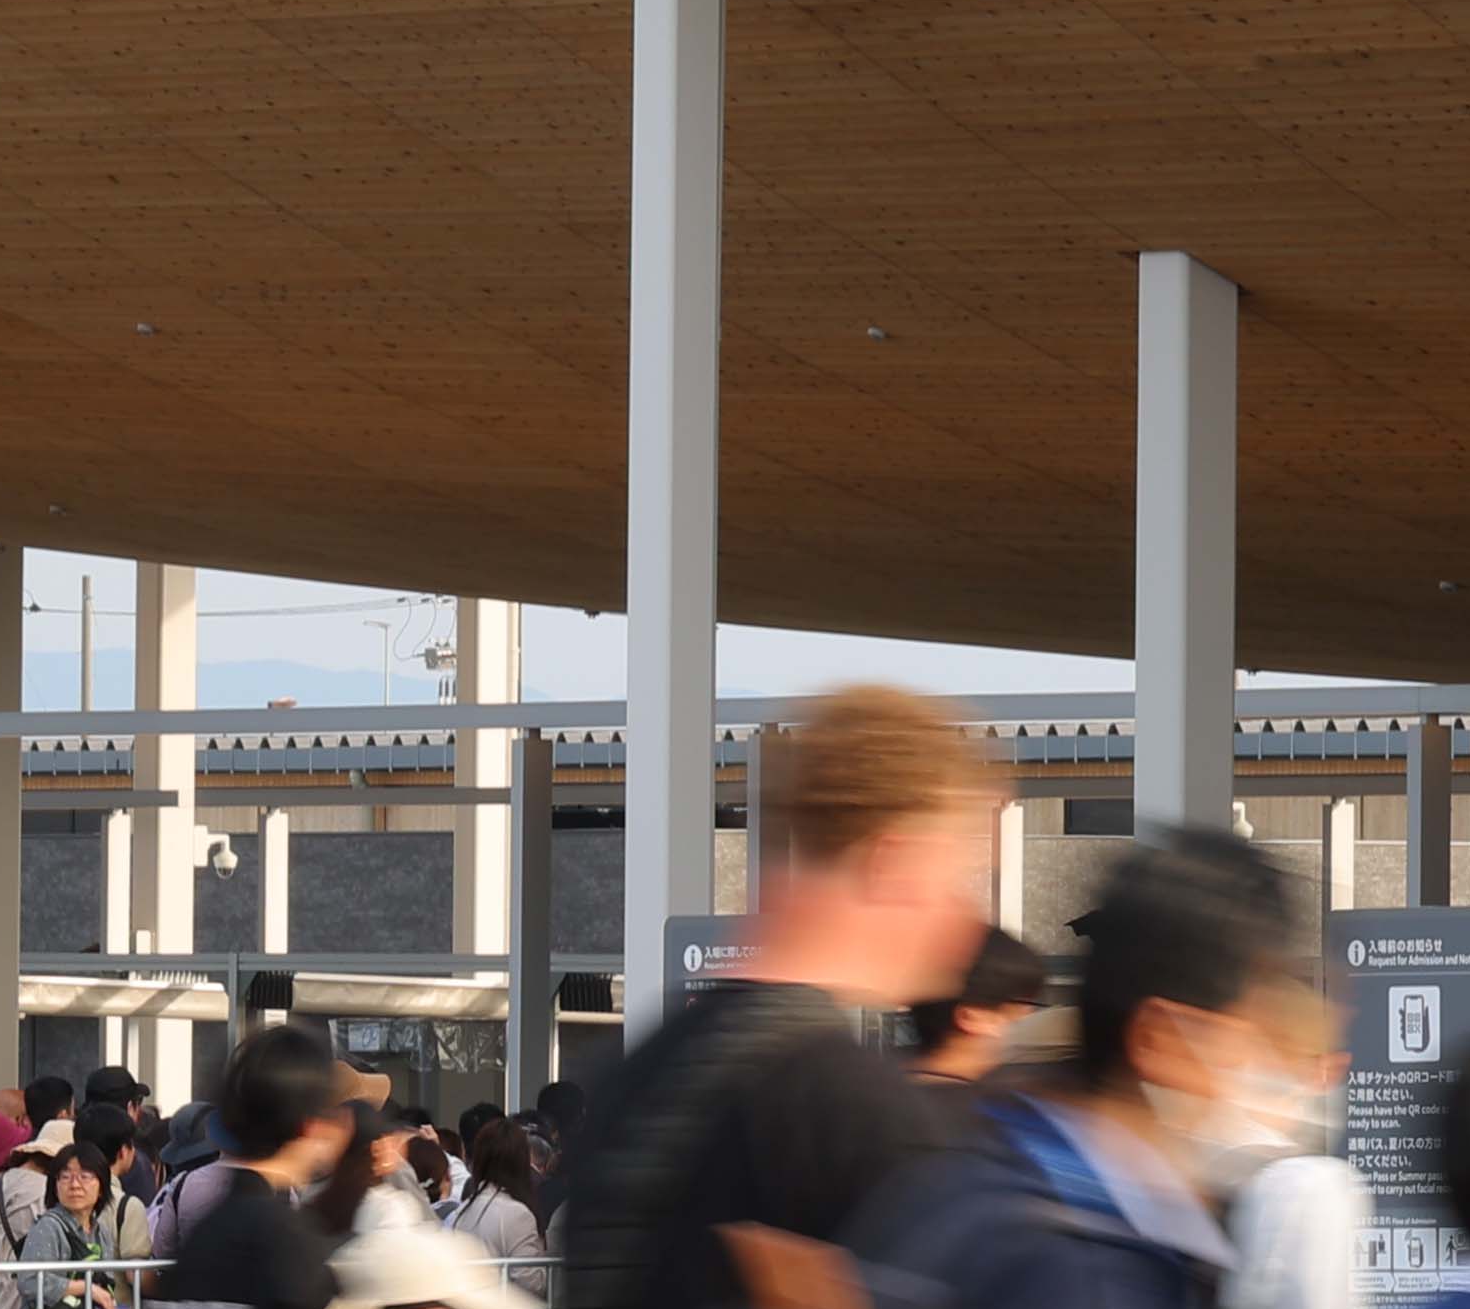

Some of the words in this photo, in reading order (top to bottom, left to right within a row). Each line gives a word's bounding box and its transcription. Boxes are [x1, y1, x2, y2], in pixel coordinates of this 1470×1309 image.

[1368, 939, 1442, 953] 入場前のお知らせ
[1368, 955, 1396, 969] Request
[1397, 955, 1407, 966] for
[1408, 954, 1444, 966] Admission
[1445, 954, 1458, 965] and
[1348, 1104, 1373, 1116] Please
[1374, 1104, 1392, 1116] have
[1394, 1104, 1406, 1115] the
[1408, 1104, 1420, 1117] QR
[1421, 1104, 1440, 1115] code
[1348, 1118, 1370, 1131] ready
[1371, 1118, 1380, 1129] to
[1381, 1119, 1401, 1129] scan.
[1373, 1170, 1389, 1183] Pass
[1398, 1171, 1426, 1183] Summer
[1386, 1184, 1403, 1197] carry
[1405, 1184, 1416, 1194] out
[1417, 1183, 1435, 1194] facial
